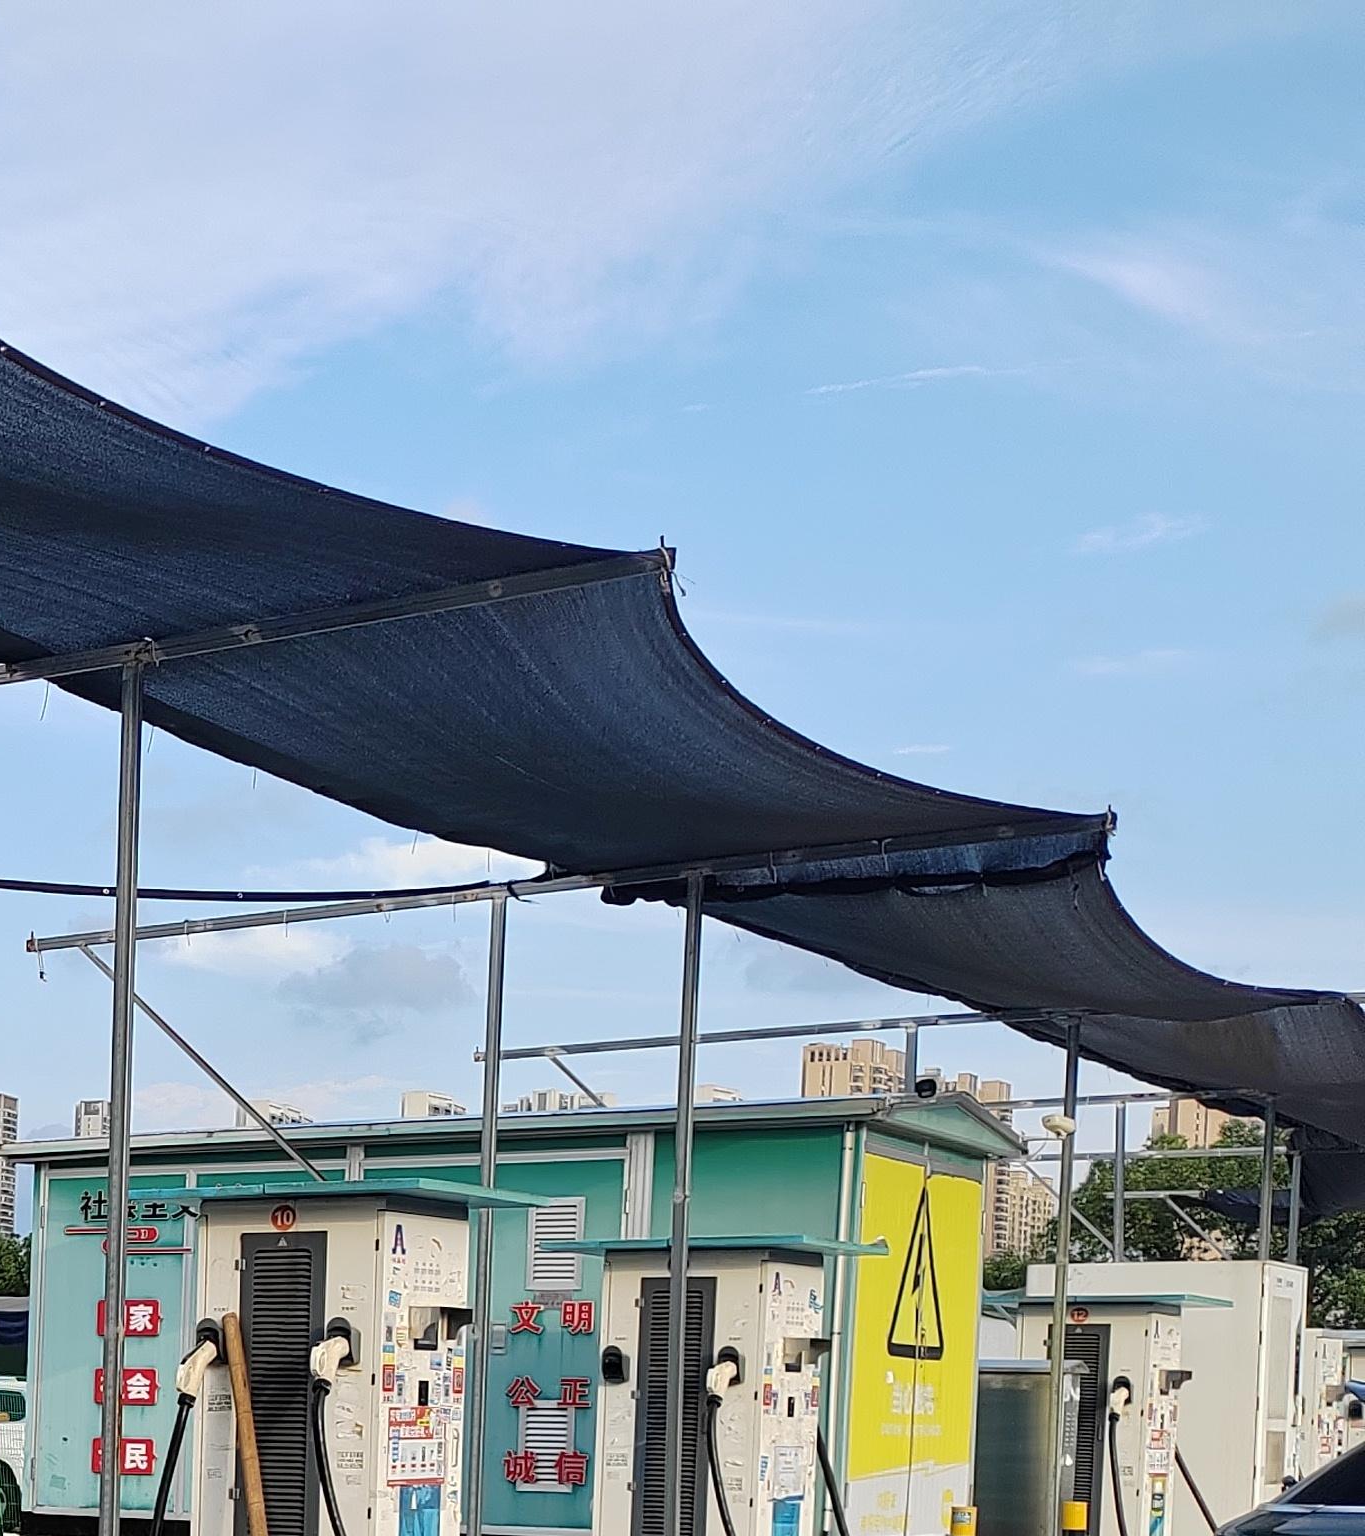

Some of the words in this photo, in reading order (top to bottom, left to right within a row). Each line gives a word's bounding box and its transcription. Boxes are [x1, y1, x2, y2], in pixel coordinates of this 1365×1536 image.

[274, 1210, 293, 1226] 10
[510, 1301, 594, 1335] 文明
[1072, 1310, 1088, 1322] 12
[506, 1376, 591, 1408] 公正
[503, 1450, 588, 1485] 诚信
